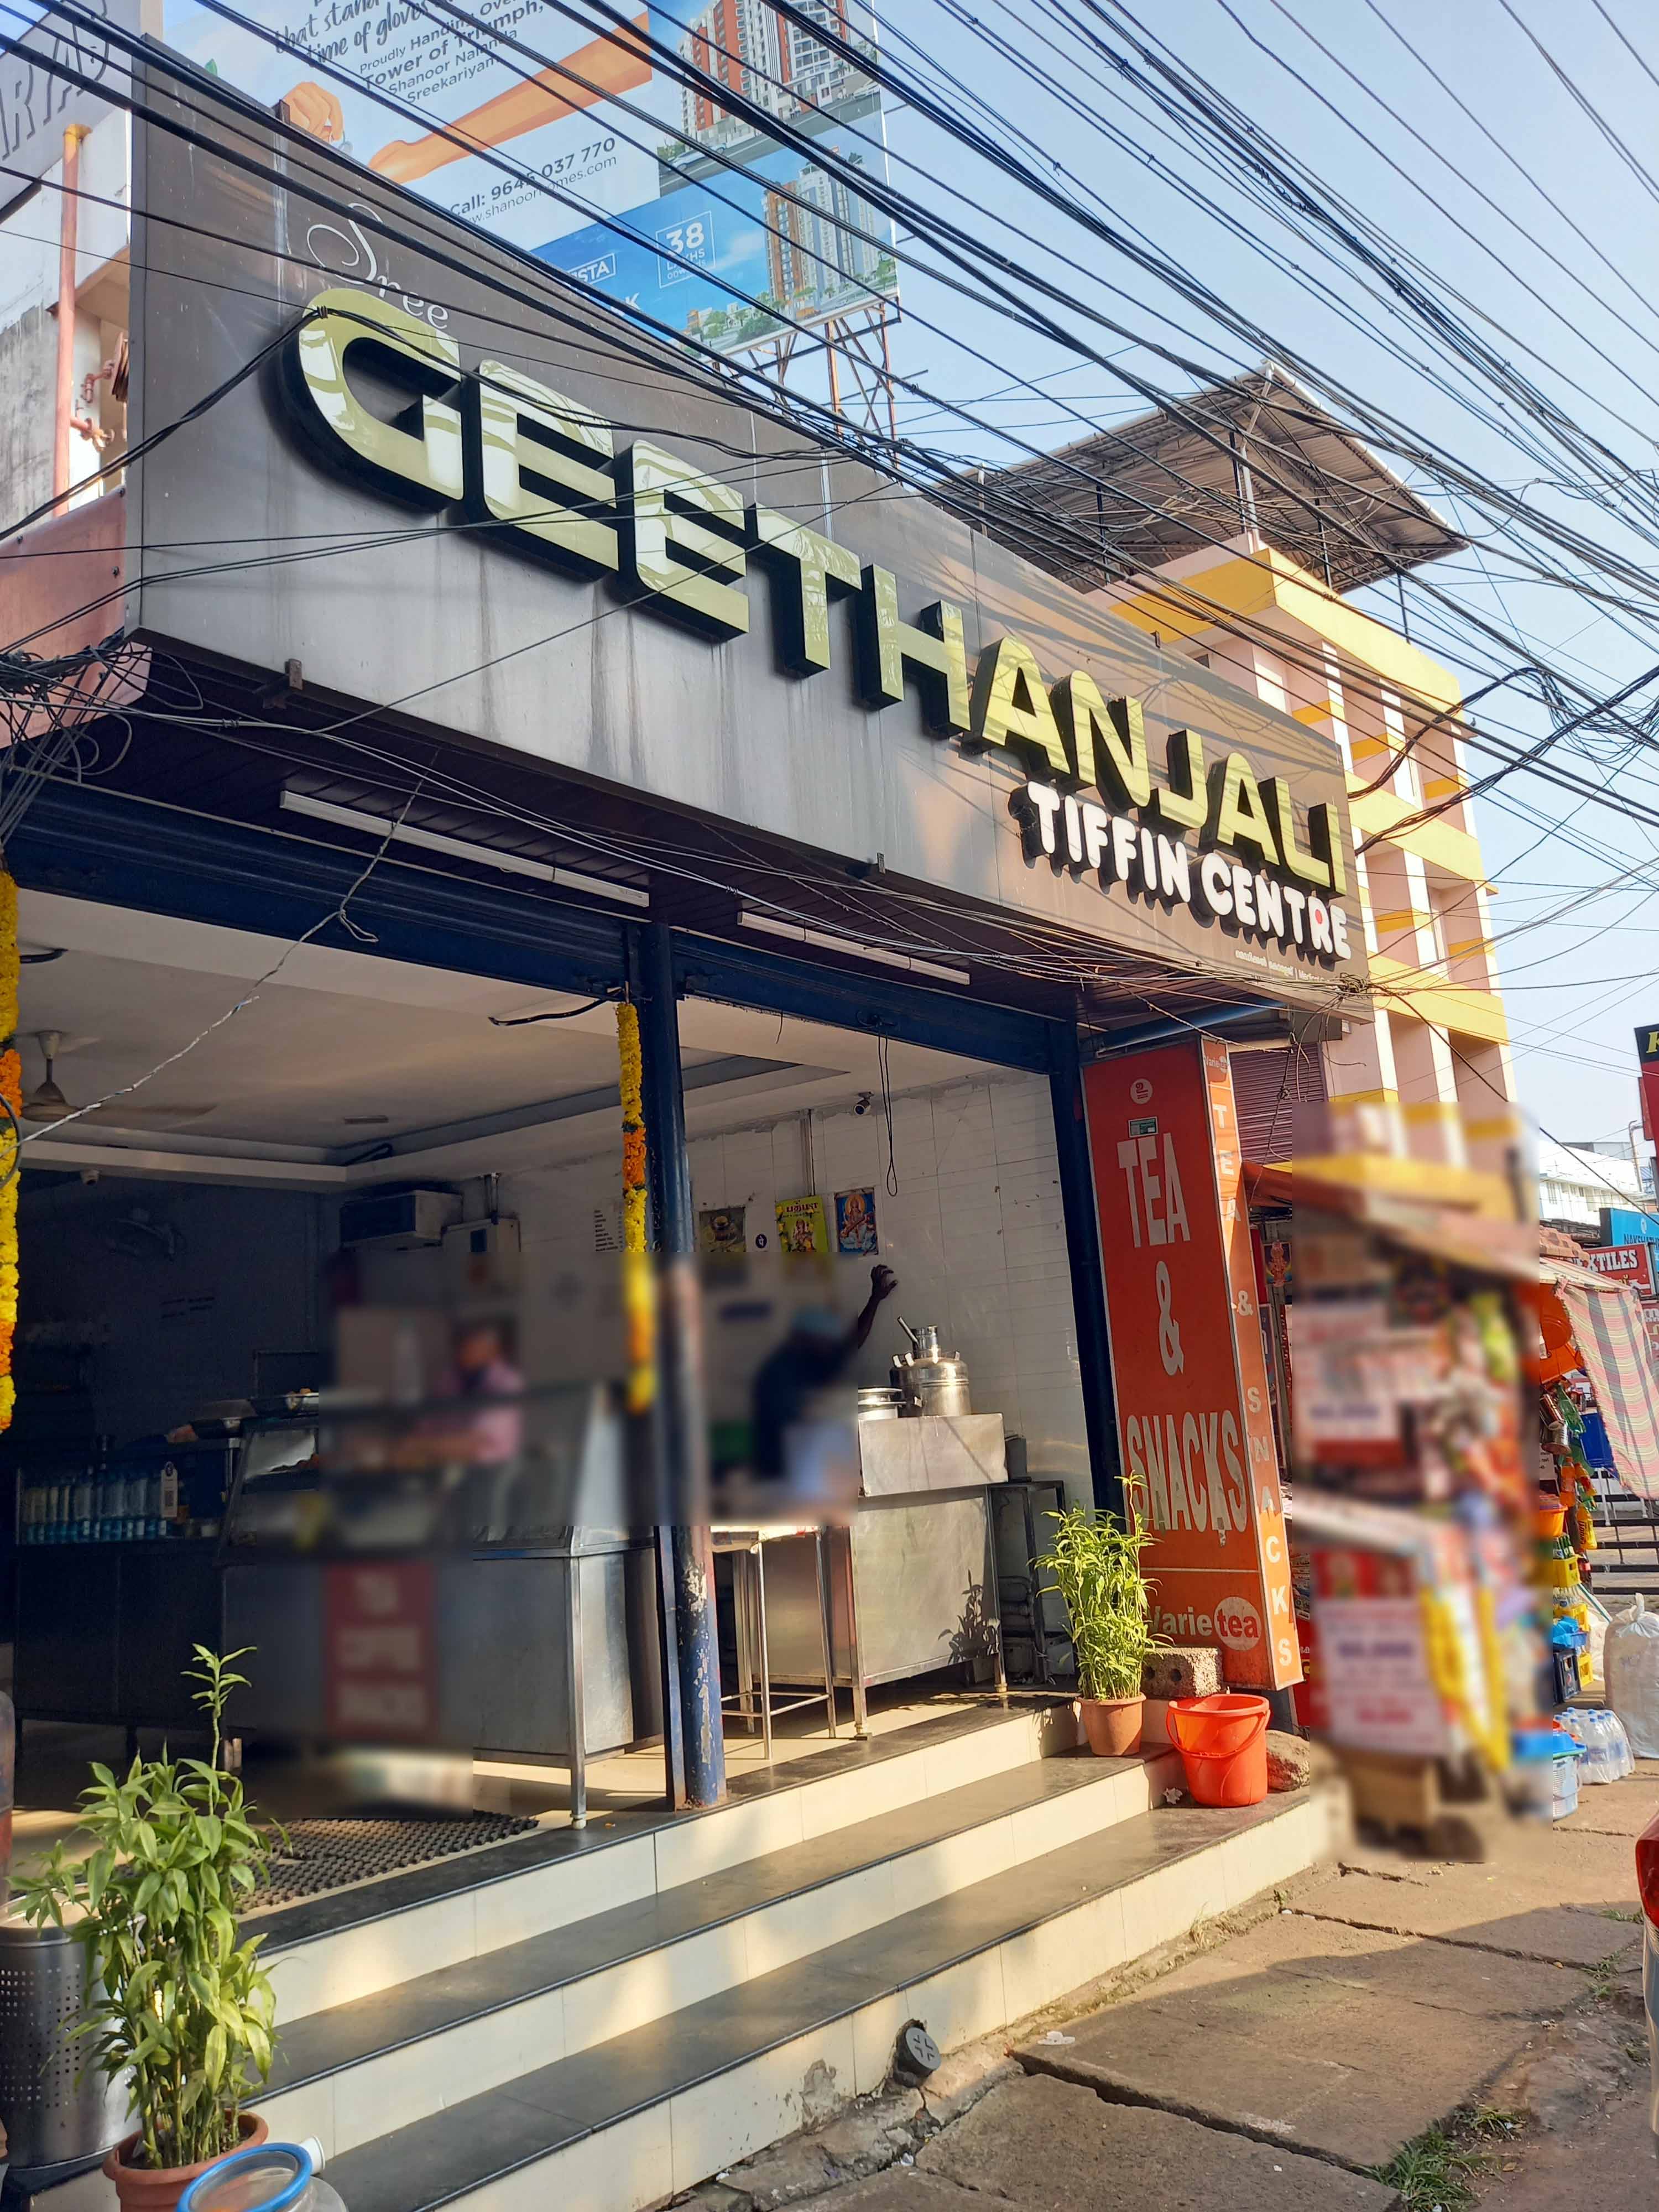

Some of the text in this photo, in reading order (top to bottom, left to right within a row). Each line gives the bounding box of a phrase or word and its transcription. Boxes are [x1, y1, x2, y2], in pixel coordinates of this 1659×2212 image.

[354, 21, 372, 54] of
[360, 0, 515, 74] Proudly Handin Ove
[363, 54, 422, 90] Tower
[429, 39, 449, 61] of
[389, 61, 450, 96] Shanoor
[450, 193, 486, 216] Call:
[541, 153, 575, 178] 037
[581, 137, 615, 163] 770
[306, 202, 449, 329] Sree
[665, 222, 705, 257] 38
[296, 287, 1348, 898] GEETHANJALI
[1027, 781, 1352, 961] TIFFIN CENTRE
[1117, 1132, 1191, 1248] TEA
[1155, 1260, 1185, 1376] &
[1237, 1290, 1254, 1316] &
[1126, 1410, 1249, 1533] SNACKS
